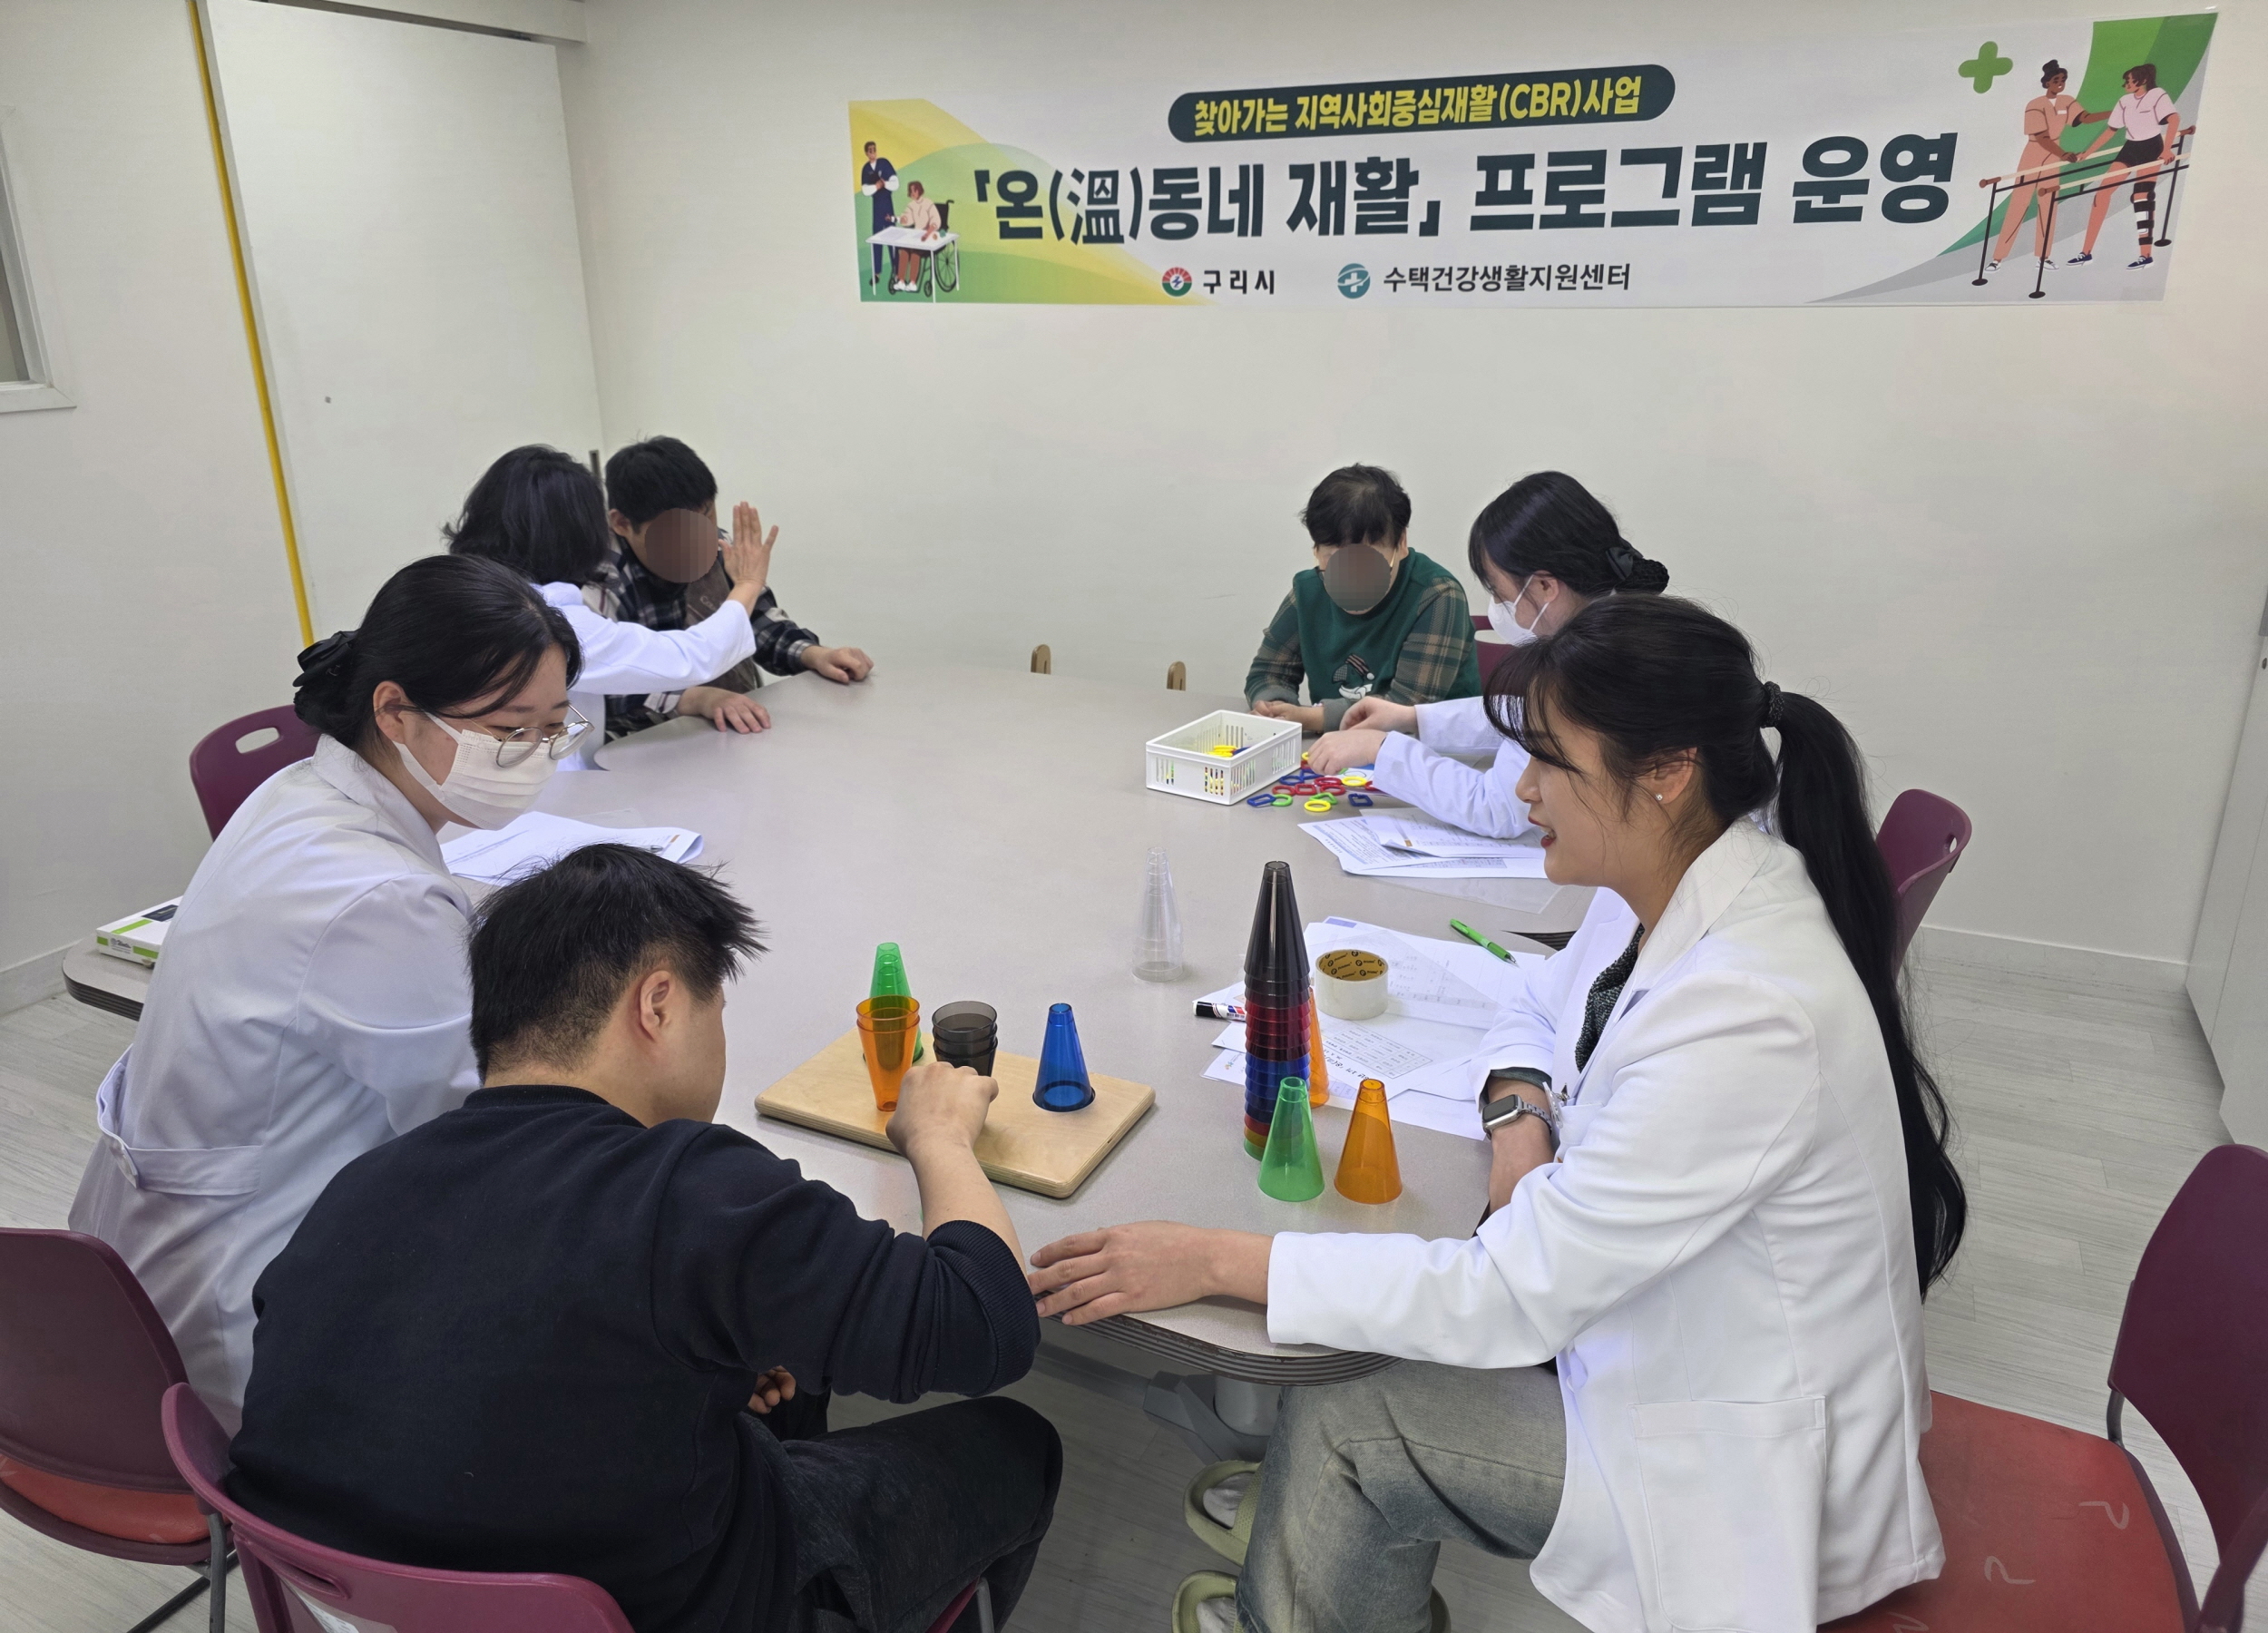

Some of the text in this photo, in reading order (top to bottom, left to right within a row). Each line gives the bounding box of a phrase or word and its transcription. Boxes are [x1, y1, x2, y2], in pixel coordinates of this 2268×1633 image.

[1194, 75, 1642, 136] 찾아가는 지역사회중심재활(CBR)사업
[1470, 142, 1768, 231] 프로그램
[1793, 132, 1959, 224] 운영
[1203, 269, 1275, 295] 구리시
[1383, 263, 1631, 292] 수택건강생활지원센터
